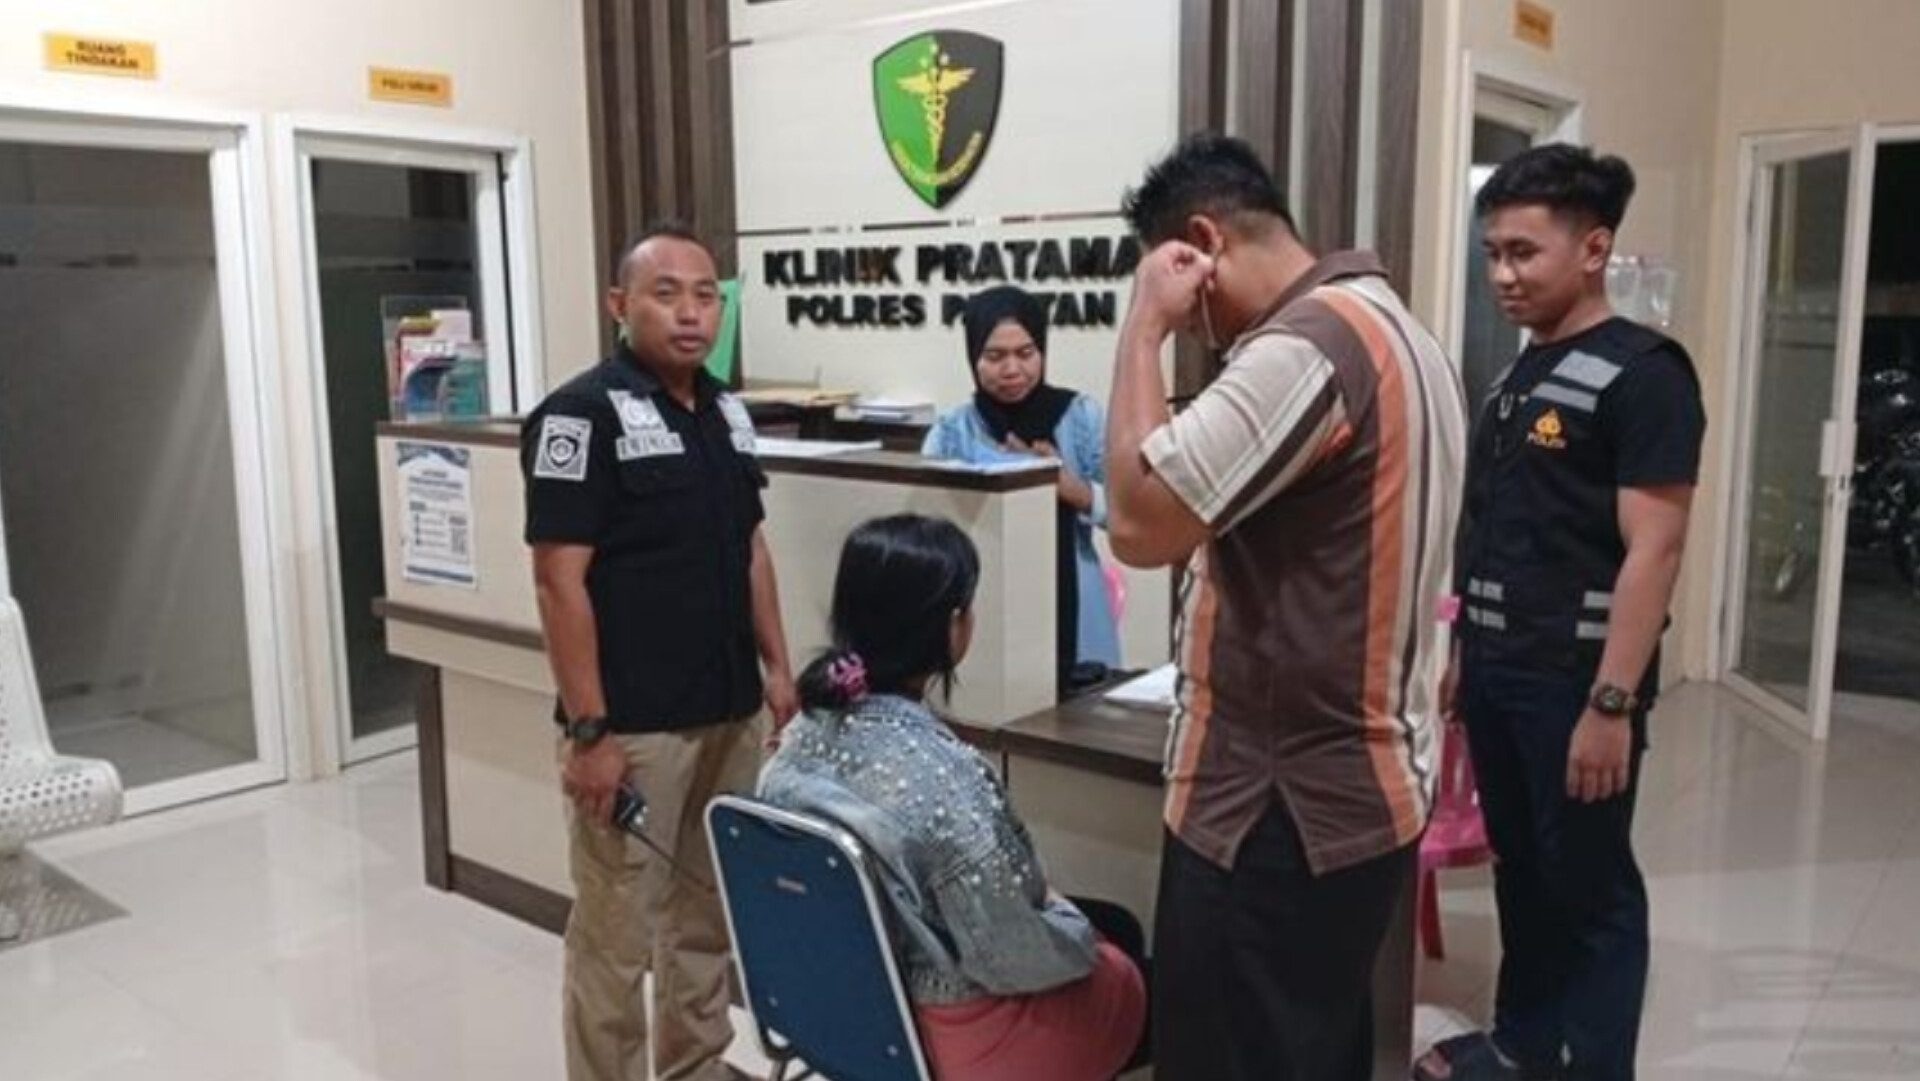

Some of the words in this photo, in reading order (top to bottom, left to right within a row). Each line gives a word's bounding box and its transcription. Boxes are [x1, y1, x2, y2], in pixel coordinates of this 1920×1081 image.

[66, 50, 139, 68] TINDAKAN
[77, 41, 125, 53] RUANG
[764, 249, 899, 285] KLINIK
[917, 237, 1140, 283] PRATAMA
[786, 293, 926, 326] POLRES
[942, 292, 1116, 326] PTAN
